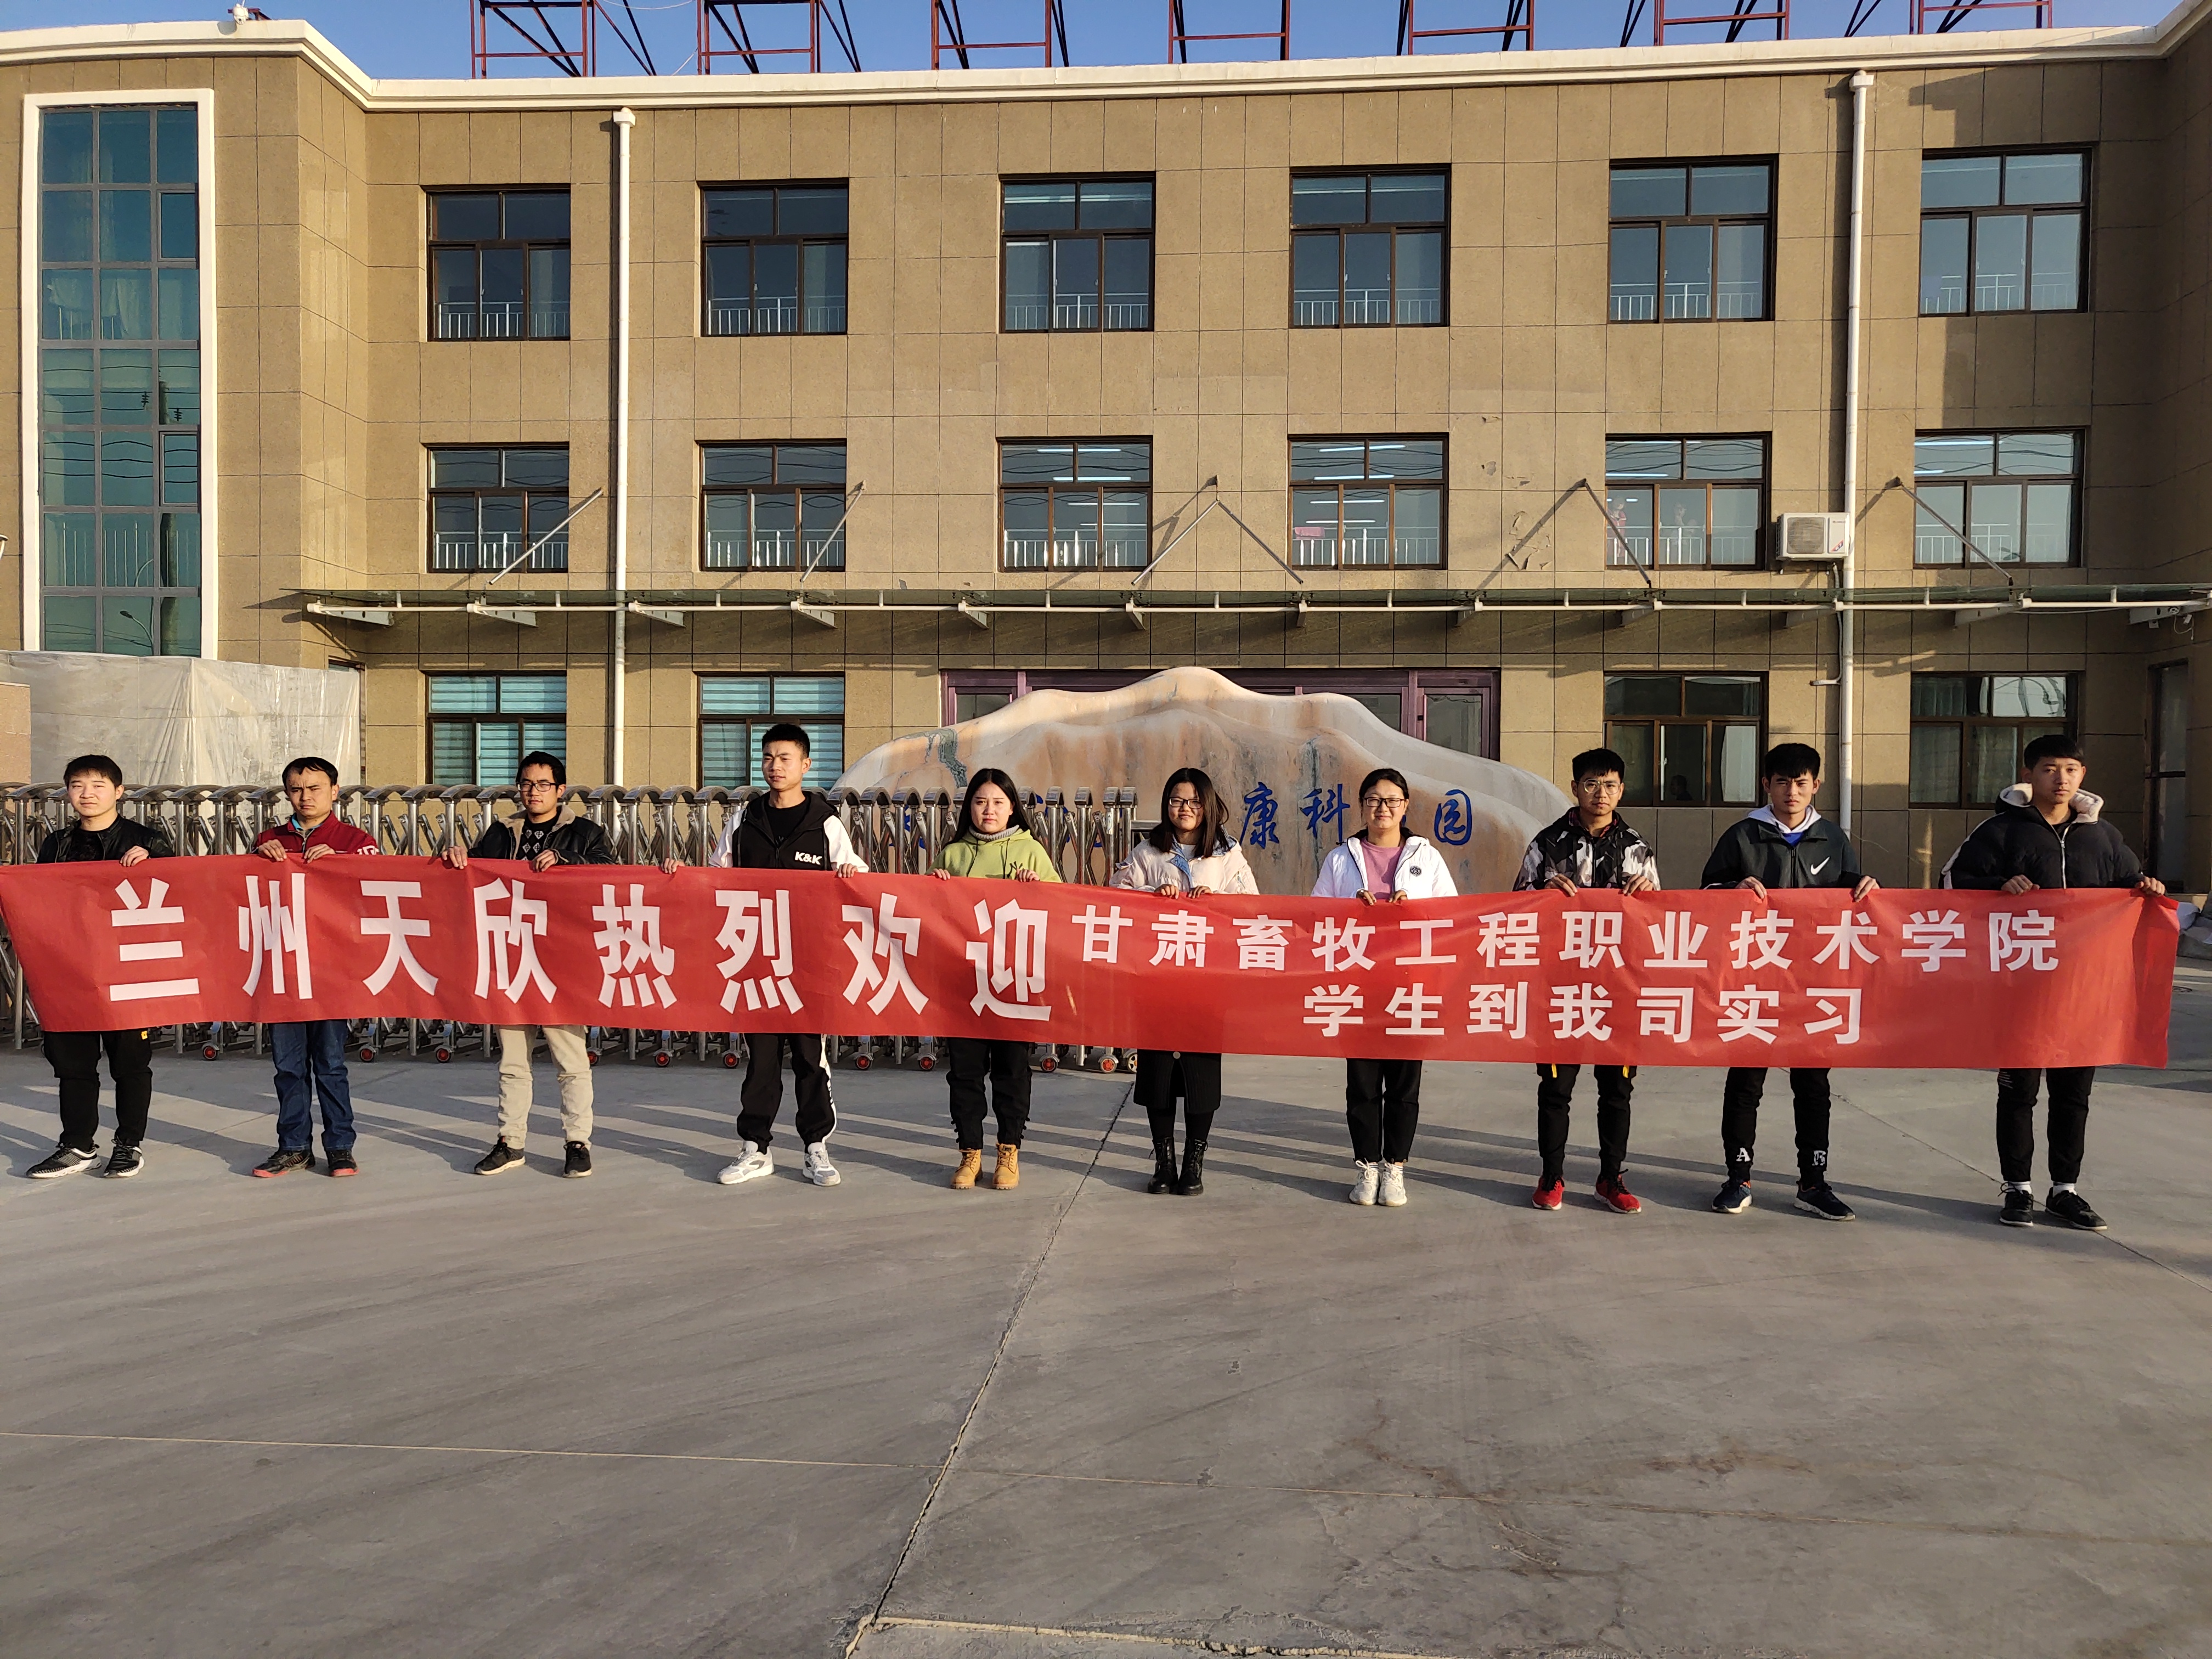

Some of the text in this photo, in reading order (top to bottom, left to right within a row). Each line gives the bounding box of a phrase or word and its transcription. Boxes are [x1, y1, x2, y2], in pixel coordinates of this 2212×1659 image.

[794, 851, 822, 865] K&K
[109, 873, 1052, 1022] 兰州天欣热烈欢迎
[1071, 905, 2059, 973] 甘肃畜牧工程职业技术学院
[1304, 981, 1862, 1045] 学生到我司实习
[1736, 1147, 1751, 1162] A
